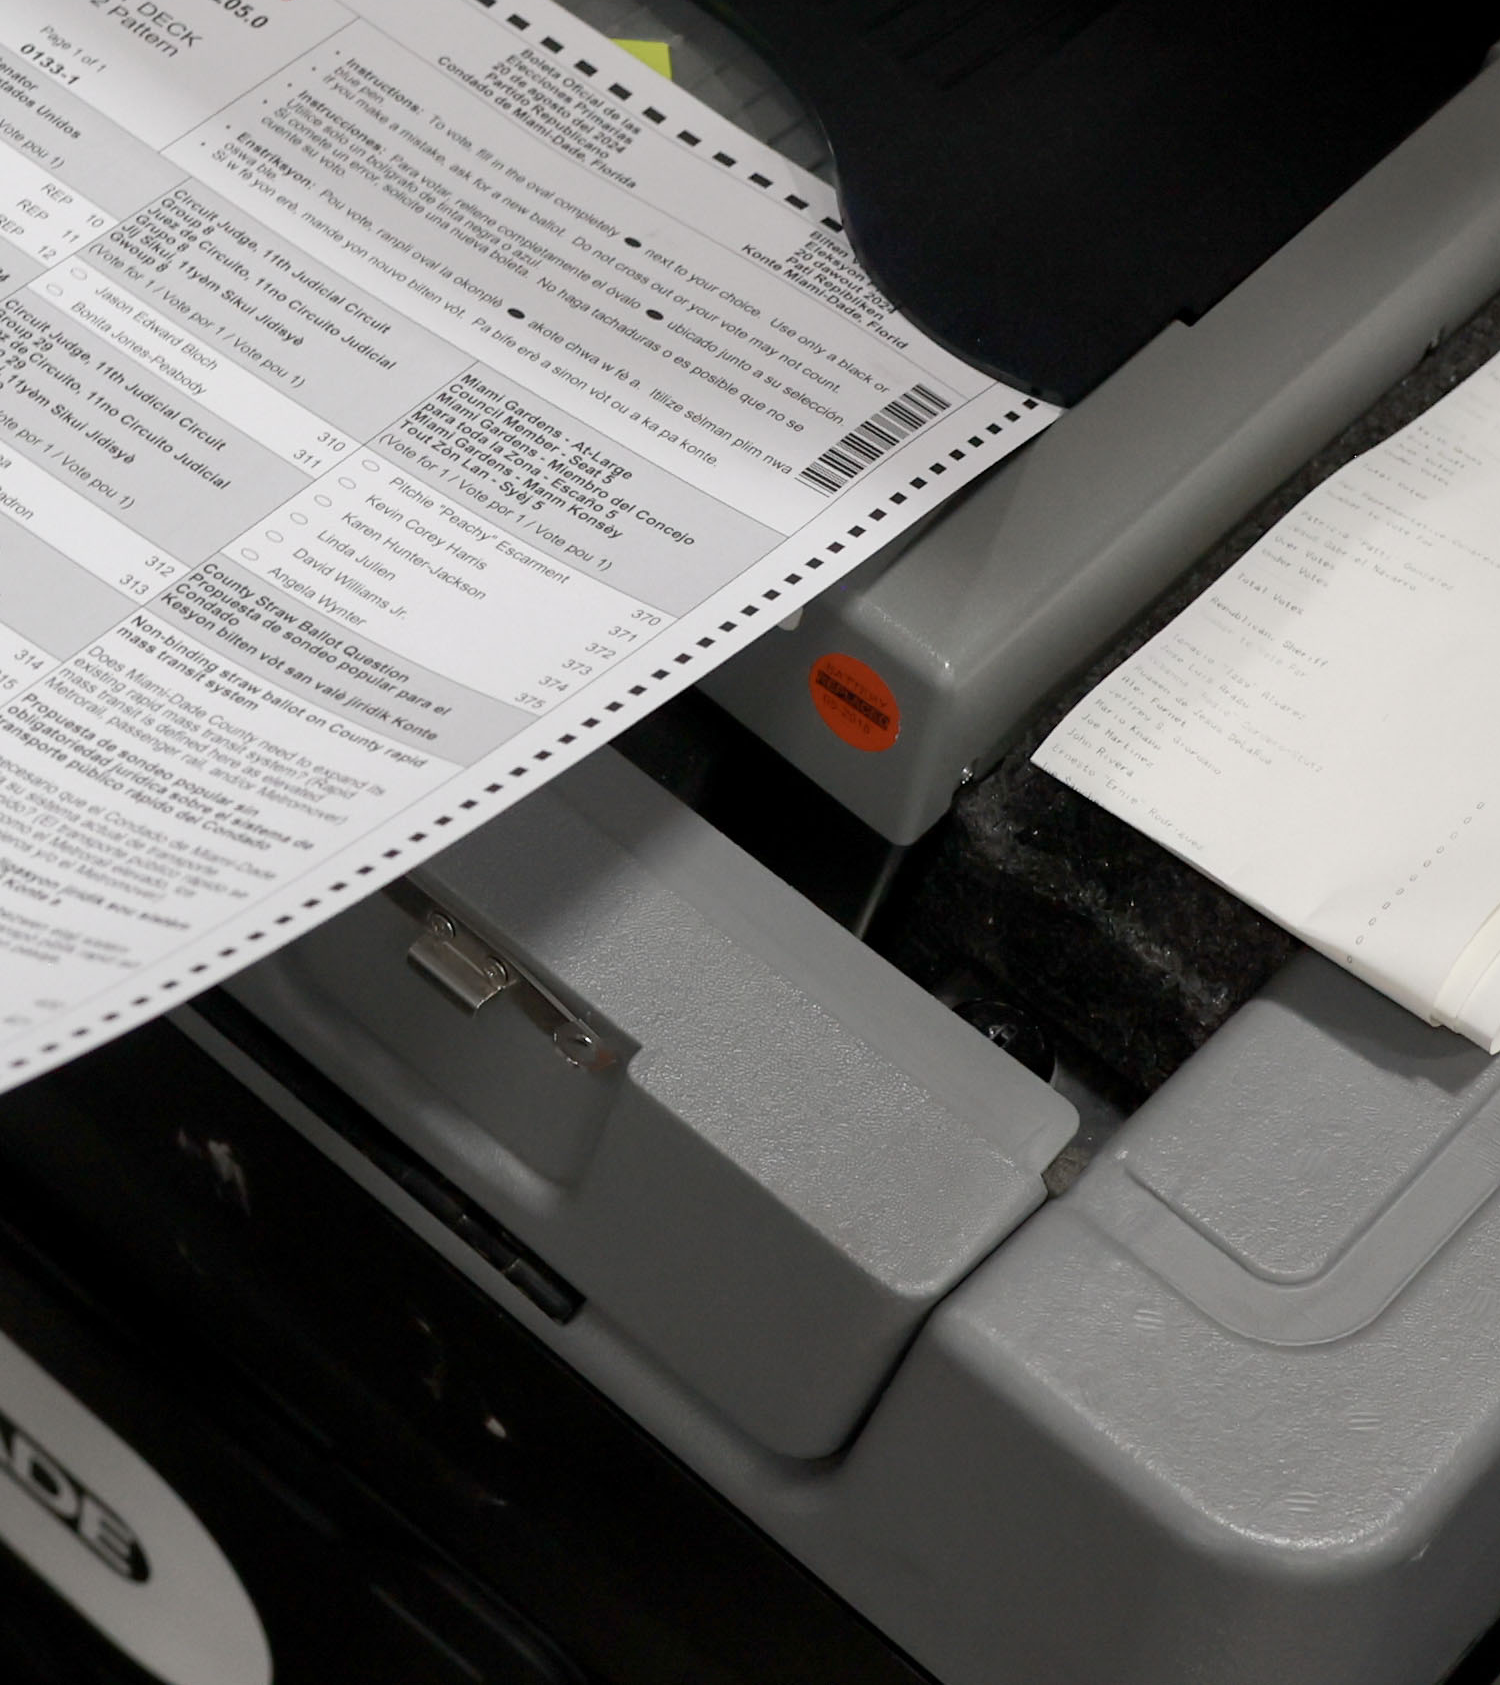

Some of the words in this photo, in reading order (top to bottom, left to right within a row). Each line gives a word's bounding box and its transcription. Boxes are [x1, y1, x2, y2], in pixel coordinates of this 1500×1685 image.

[108, 4, 179, 58] Pattern
[138, 1, 204, 47] DECK
[19, 42, 80, 86] 0133-1
[202, 562, 254, 603] County
[255, 594, 297, 624] Straw
[297, 619, 341, 649] Ballot
[341, 645, 411, 684] Question
